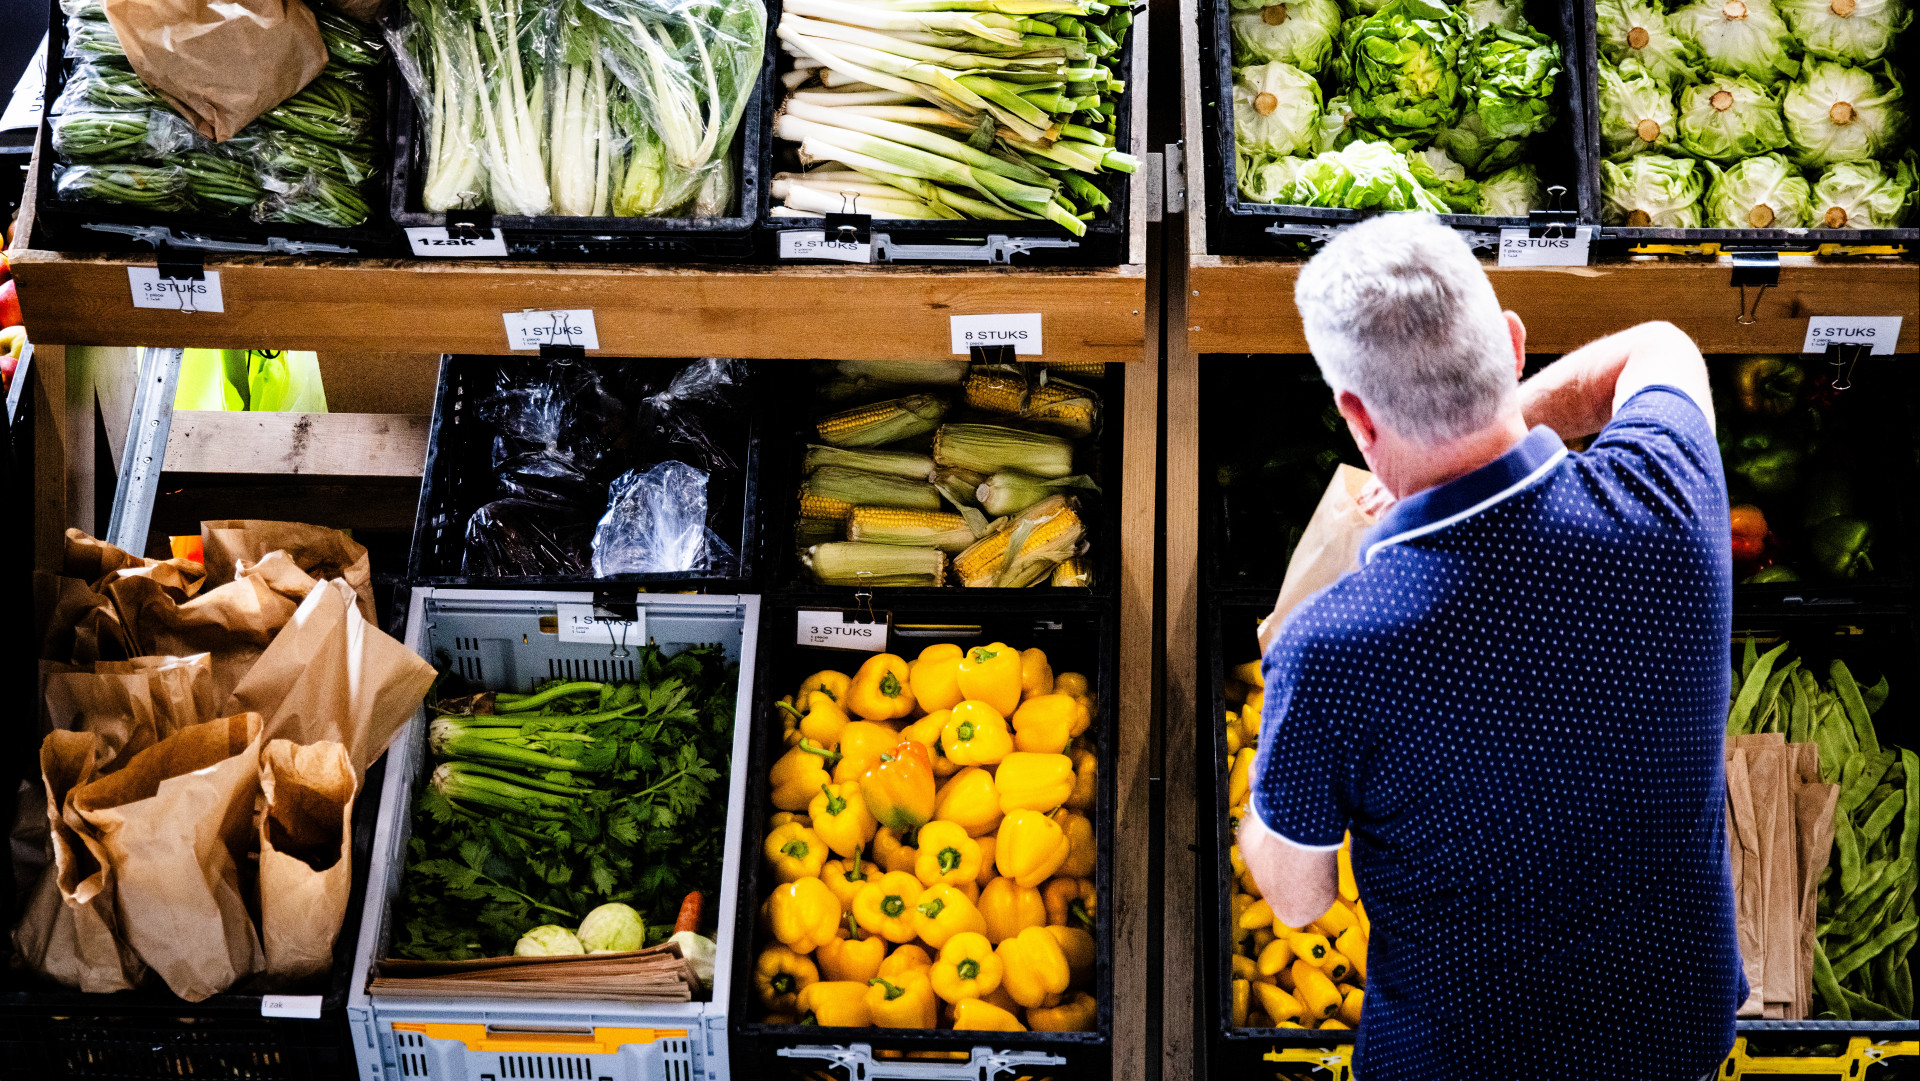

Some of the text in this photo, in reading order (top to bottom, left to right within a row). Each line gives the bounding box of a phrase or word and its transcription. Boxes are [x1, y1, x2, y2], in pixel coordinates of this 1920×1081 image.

[808, 240, 858, 250] STUKS
[1504, 240, 1568, 248] 2 STUKS
[144, 282, 206, 294] 3 STUKS
[534, 326, 582, 336] STUKS
[966, 330, 1028, 340] 8 STUKS
[1812, 328, 1876, 336] 5 STUKS
[572, 616, 578, 624] 1
[824, 626, 872, 636] STUKS
